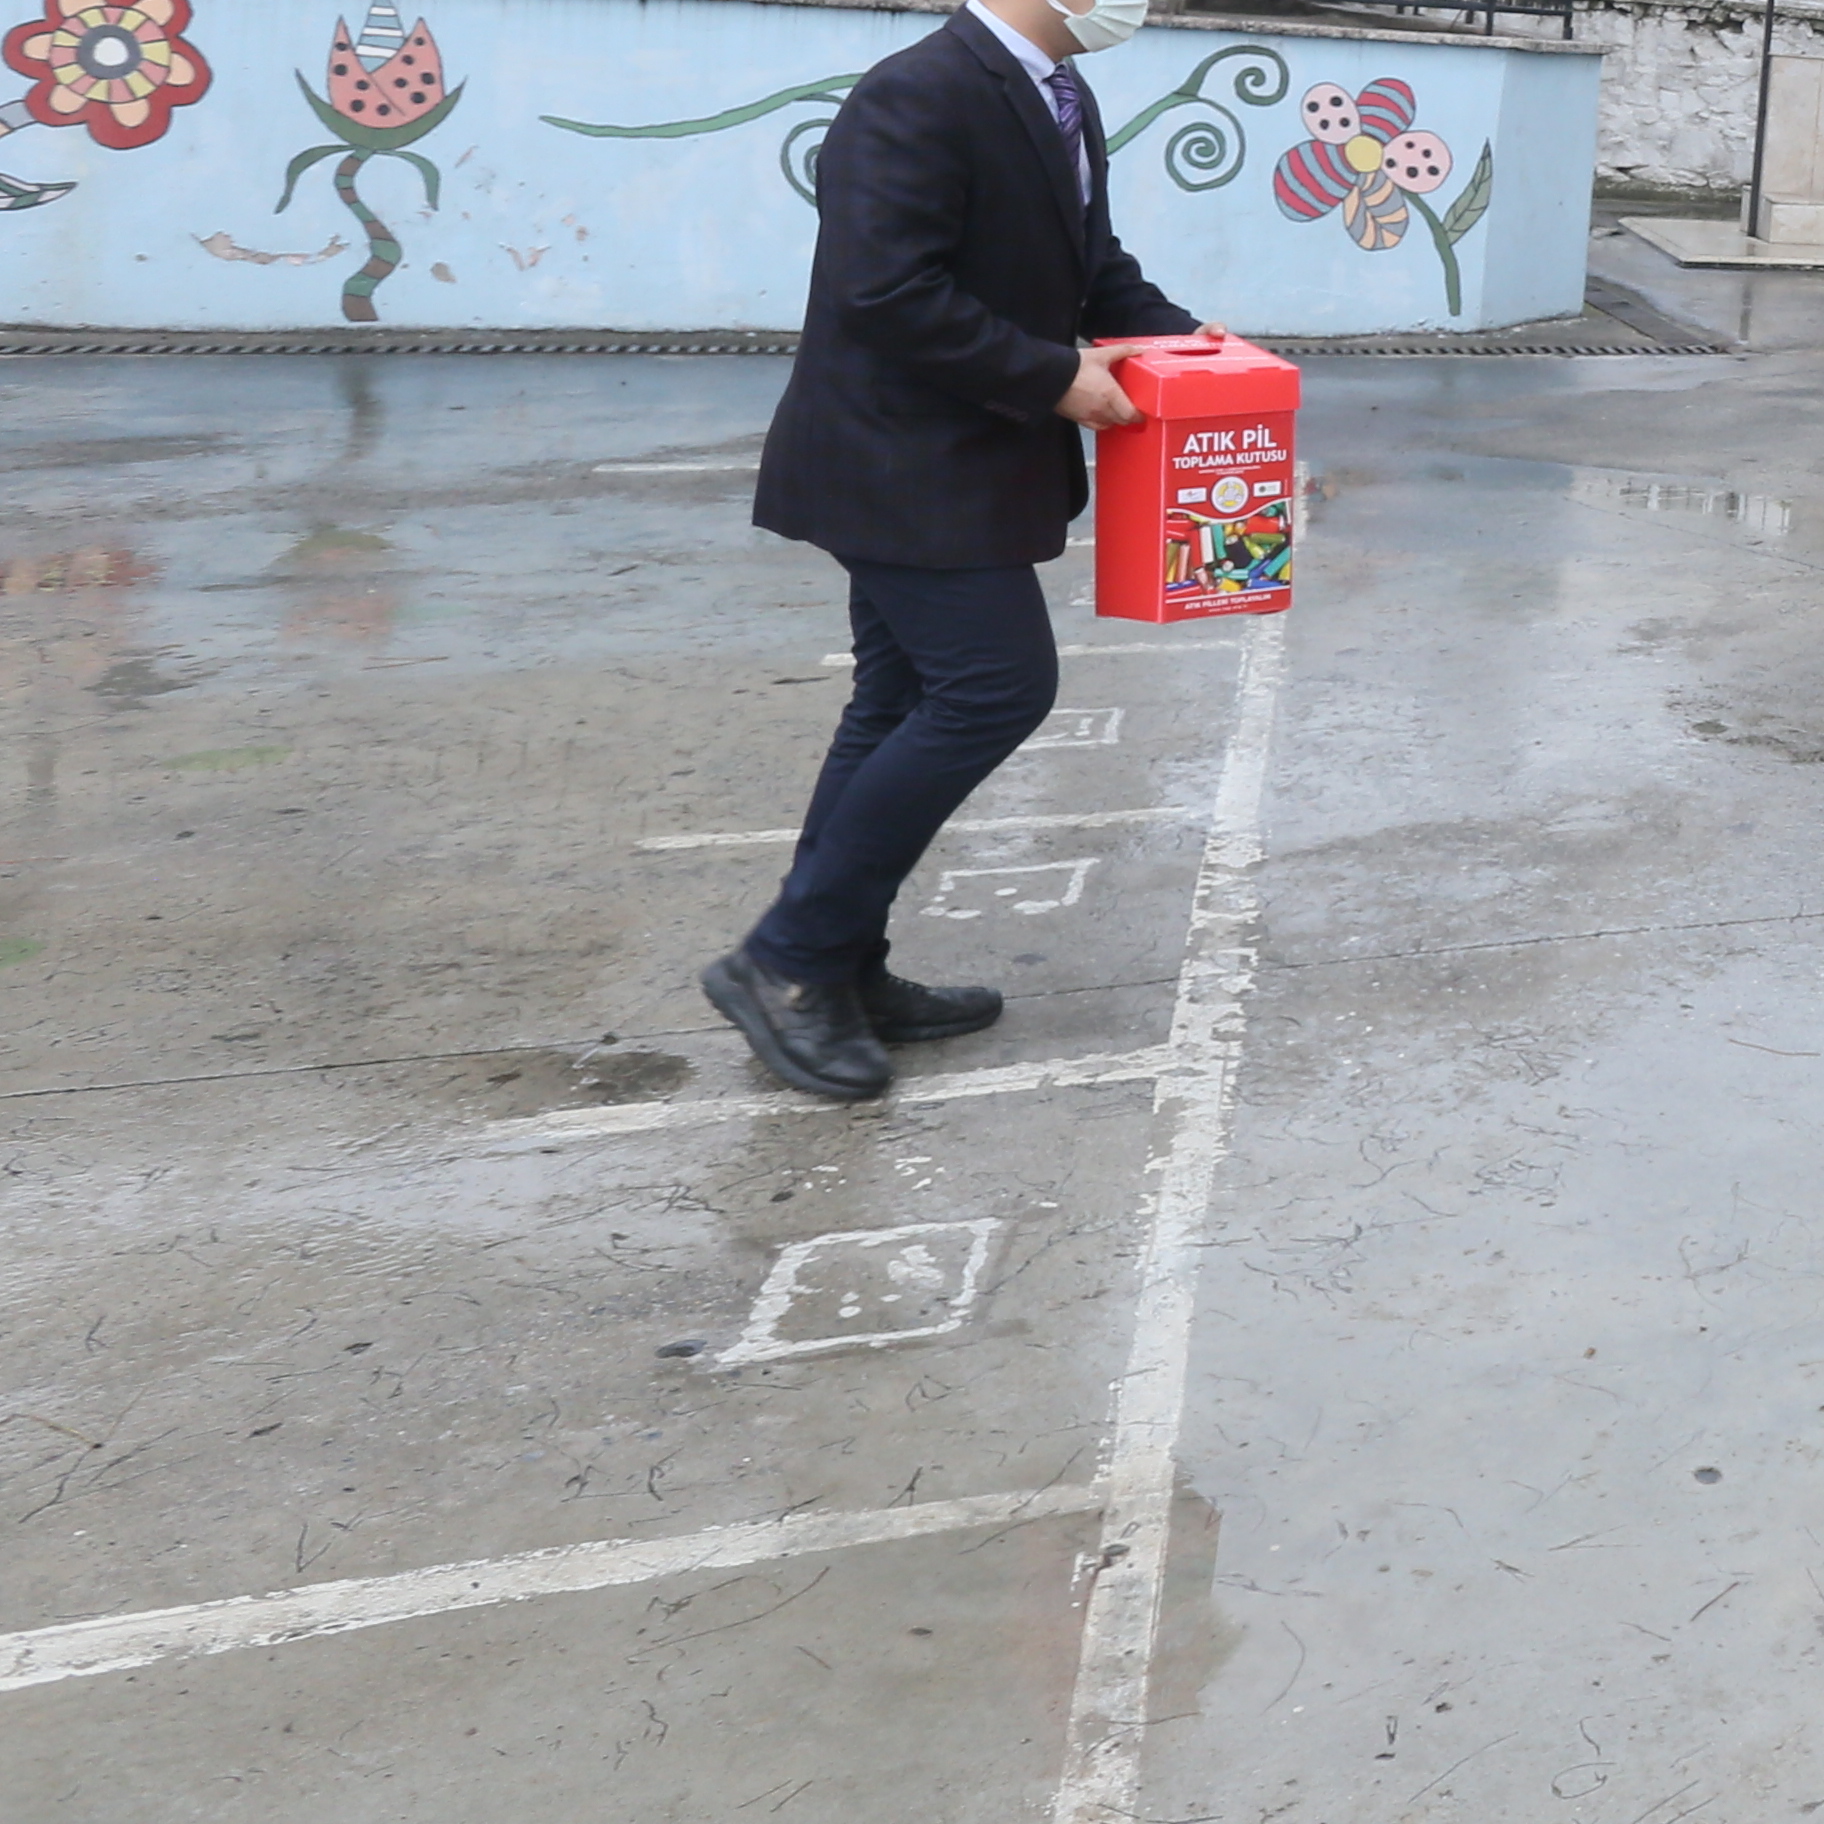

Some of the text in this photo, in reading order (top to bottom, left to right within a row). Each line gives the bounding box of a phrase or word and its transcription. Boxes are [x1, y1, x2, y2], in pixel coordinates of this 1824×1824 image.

[1183, 423, 1277, 454] ATIK PİL
[1172, 449, 1287, 469] TOPLAMA KUTUSU
